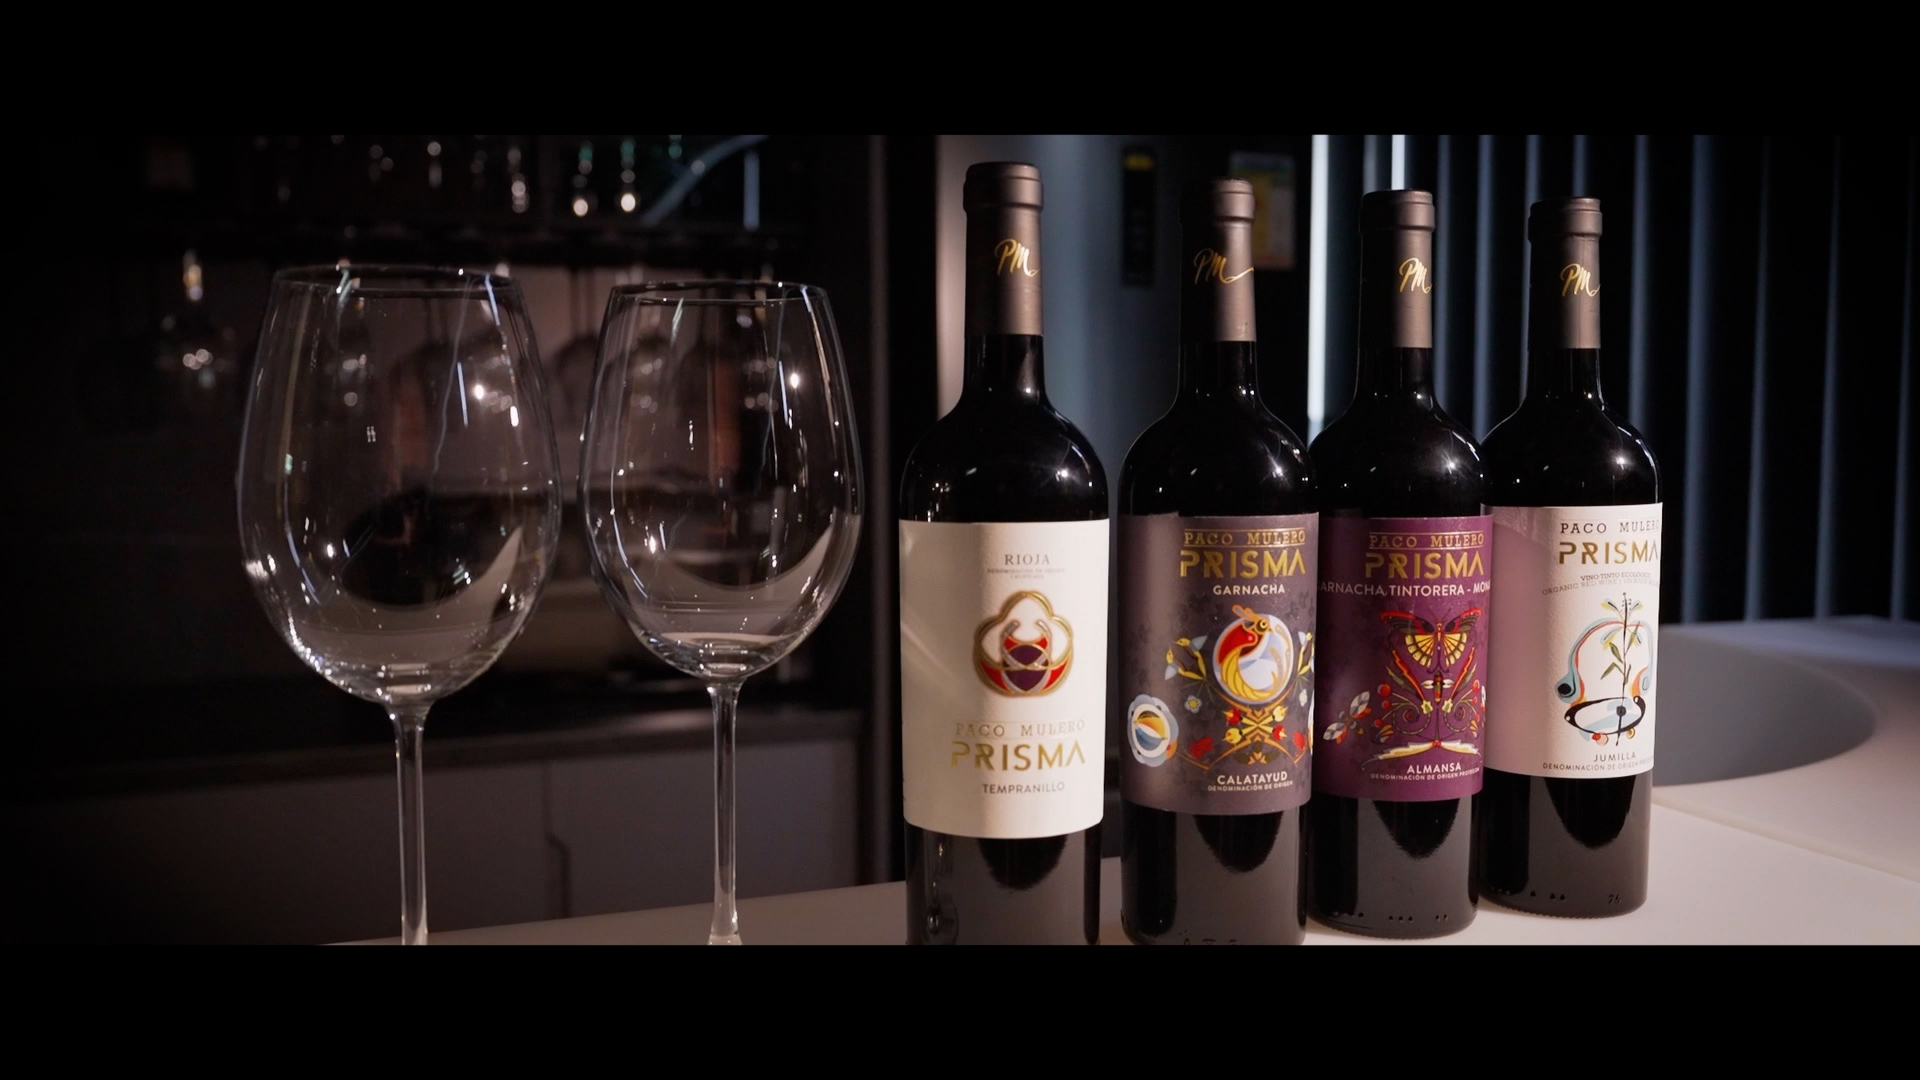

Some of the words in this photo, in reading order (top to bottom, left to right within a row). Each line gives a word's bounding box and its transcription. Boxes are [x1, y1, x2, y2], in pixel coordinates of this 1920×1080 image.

[1559, 522, 1607, 534] PACO
[1183, 530, 1234, 546] PACO
[1247, 529, 1306, 545] MULERO
[1368, 535, 1418, 548] PACO
[1430, 532, 1485, 547] MULERO
[1558, 539, 1659, 565] PRISMA
[1004, 554, 1050, 566] RIOJA
[1179, 548, 1306, 578] PRISMA
[1365, 550, 1485, 580] PRISMA
[1580, 573, 1599, 582] VINO
[1600, 572, 1620, 580] TINTO
[1213, 583, 1286, 596] GARNACHA
[1388, 584, 1465, 597] TINTORERA
[1541, 583, 1579, 596] ORGANIC
[955, 722, 1005, 737] PACO
[1020, 719, 1086, 737] MULERO
[951, 739, 1086, 771] PRISMA
[1593, 751, 1637, 763] JUMILLA
[1406, 762, 1462, 774] ALMANSA
[1542, 762, 1605, 771] DENOMINACIÓN
[1216, 771, 1288, 785] CALATAYUD
[982, 781, 1065, 795] TEMPRANILLO
